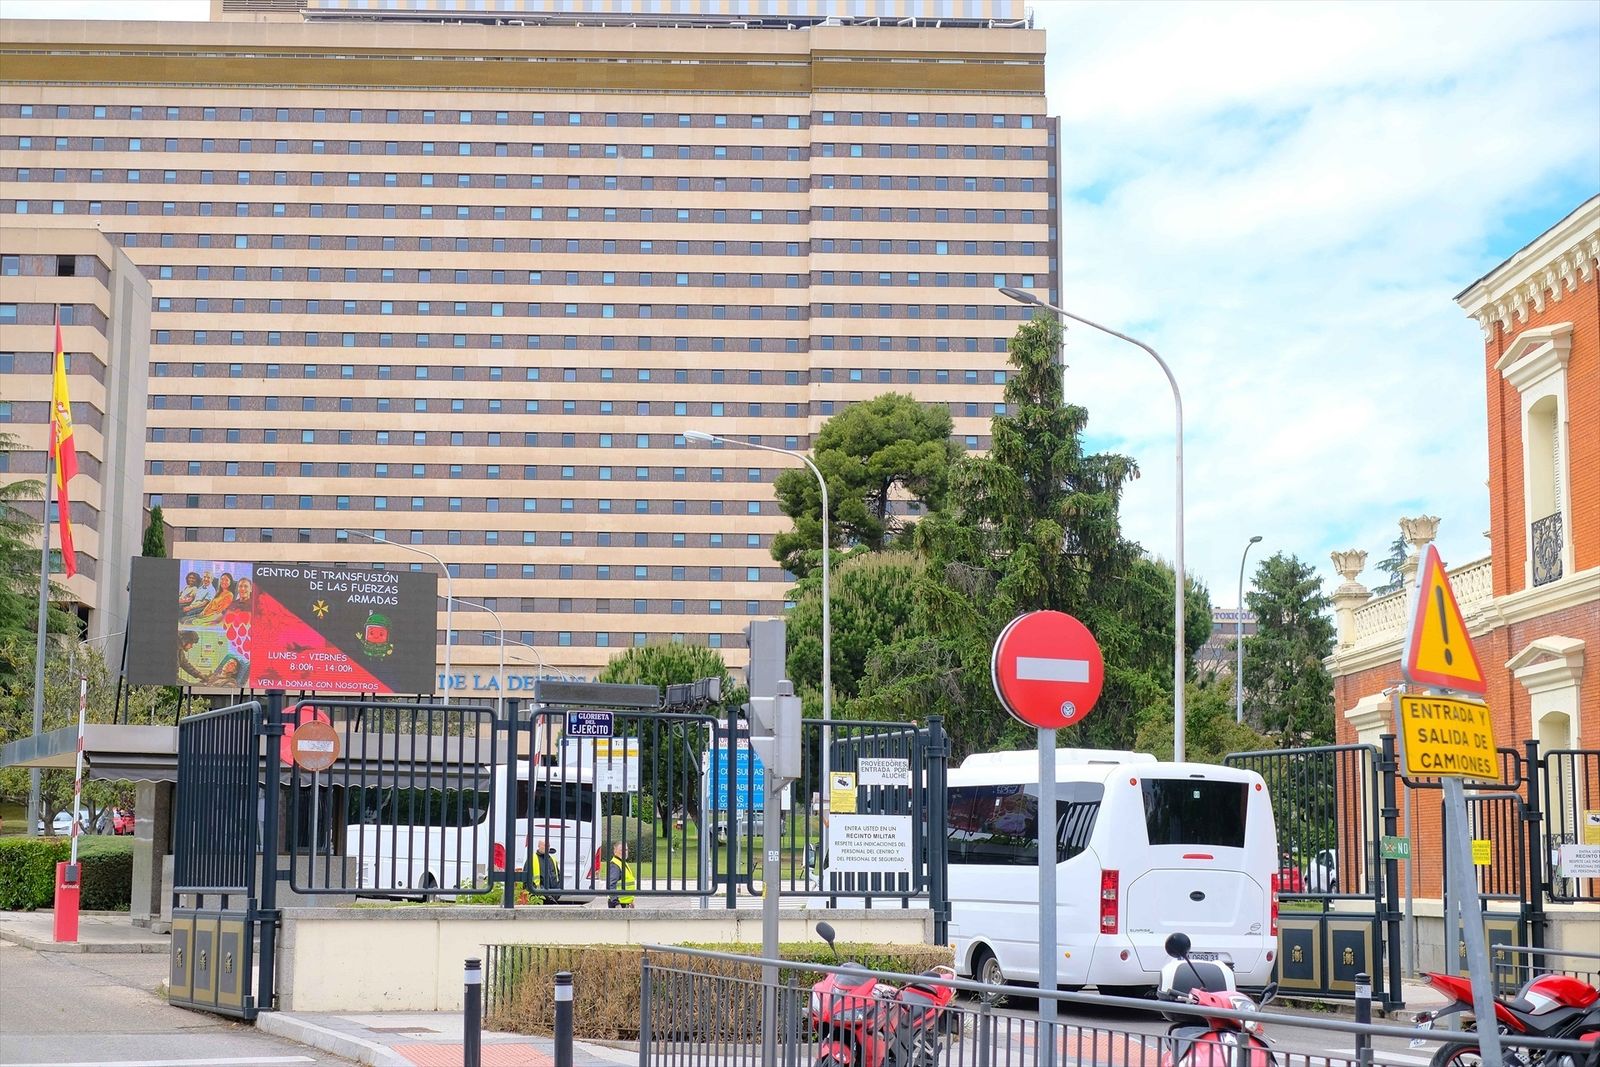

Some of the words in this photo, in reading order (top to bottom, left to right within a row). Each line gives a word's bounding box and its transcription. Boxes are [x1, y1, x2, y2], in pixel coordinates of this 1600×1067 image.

[256, 567, 300, 578] CENTRO
[304, 570, 317, 579] DE
[322, 571, 399, 583] TRANSFUSIÓN
[310, 581, 323, 590] DE
[328, 582, 347, 592] LAS
[352, 584, 398, 594] FUERZAS
[347, 594, 398, 605] ARMADAS
[309, 653, 347, 662] VIERNES
[438, 675, 467, 690] DE
[474, 675, 501, 690] LA
[1410, 703, 1474, 724] ENTRADA
[1479, 710, 1486, 726] Y
[572, 724, 608, 734] EJERCITO
[1418, 728, 1469, 746] SALIDA
[1474, 733, 1488, 749] DE
[1421, 753, 1491, 774] CAMIONES
[1398, 842, 1408, 854] NO
